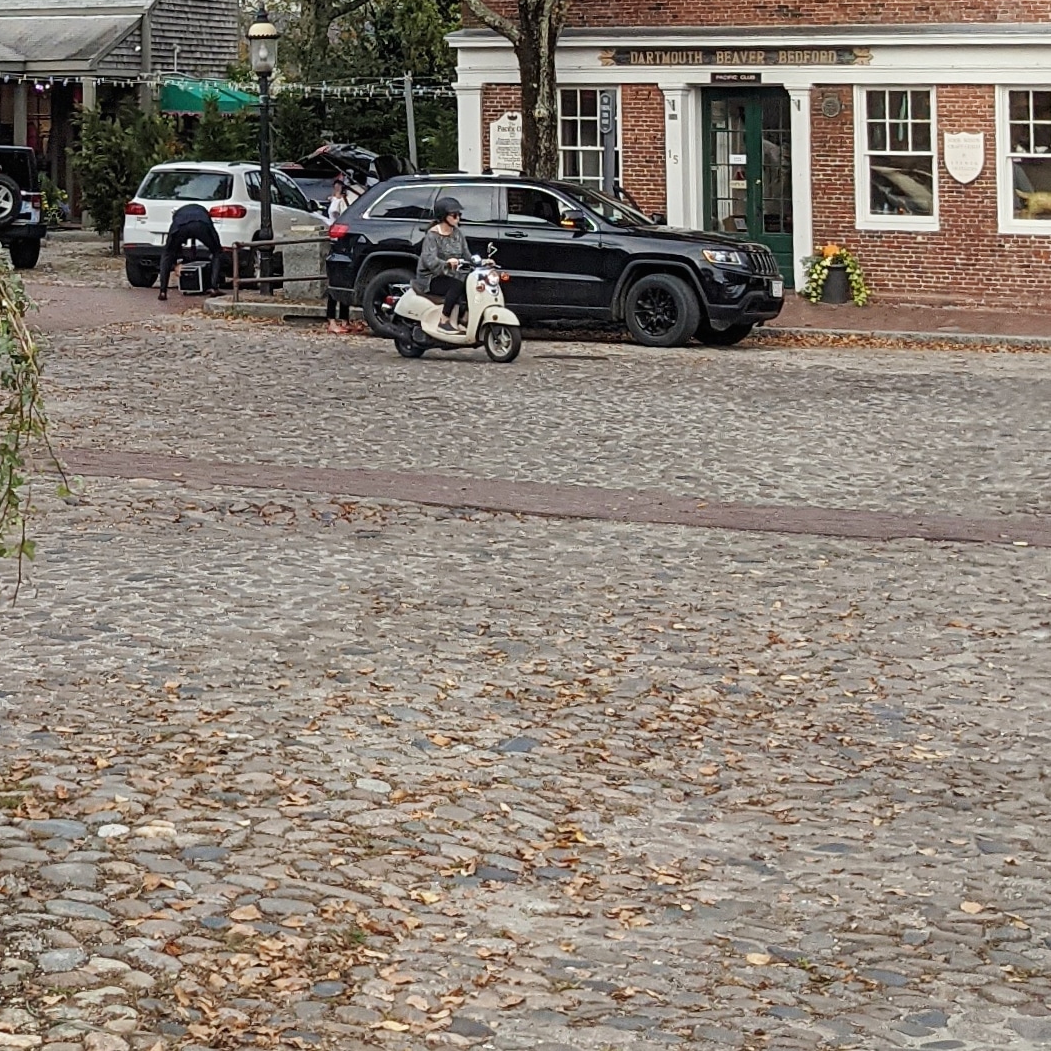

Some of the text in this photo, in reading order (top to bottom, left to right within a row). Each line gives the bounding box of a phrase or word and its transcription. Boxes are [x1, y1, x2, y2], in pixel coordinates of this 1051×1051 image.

[630, 50, 837, 65] DARTMOUTH BEAVER BEDFORD
